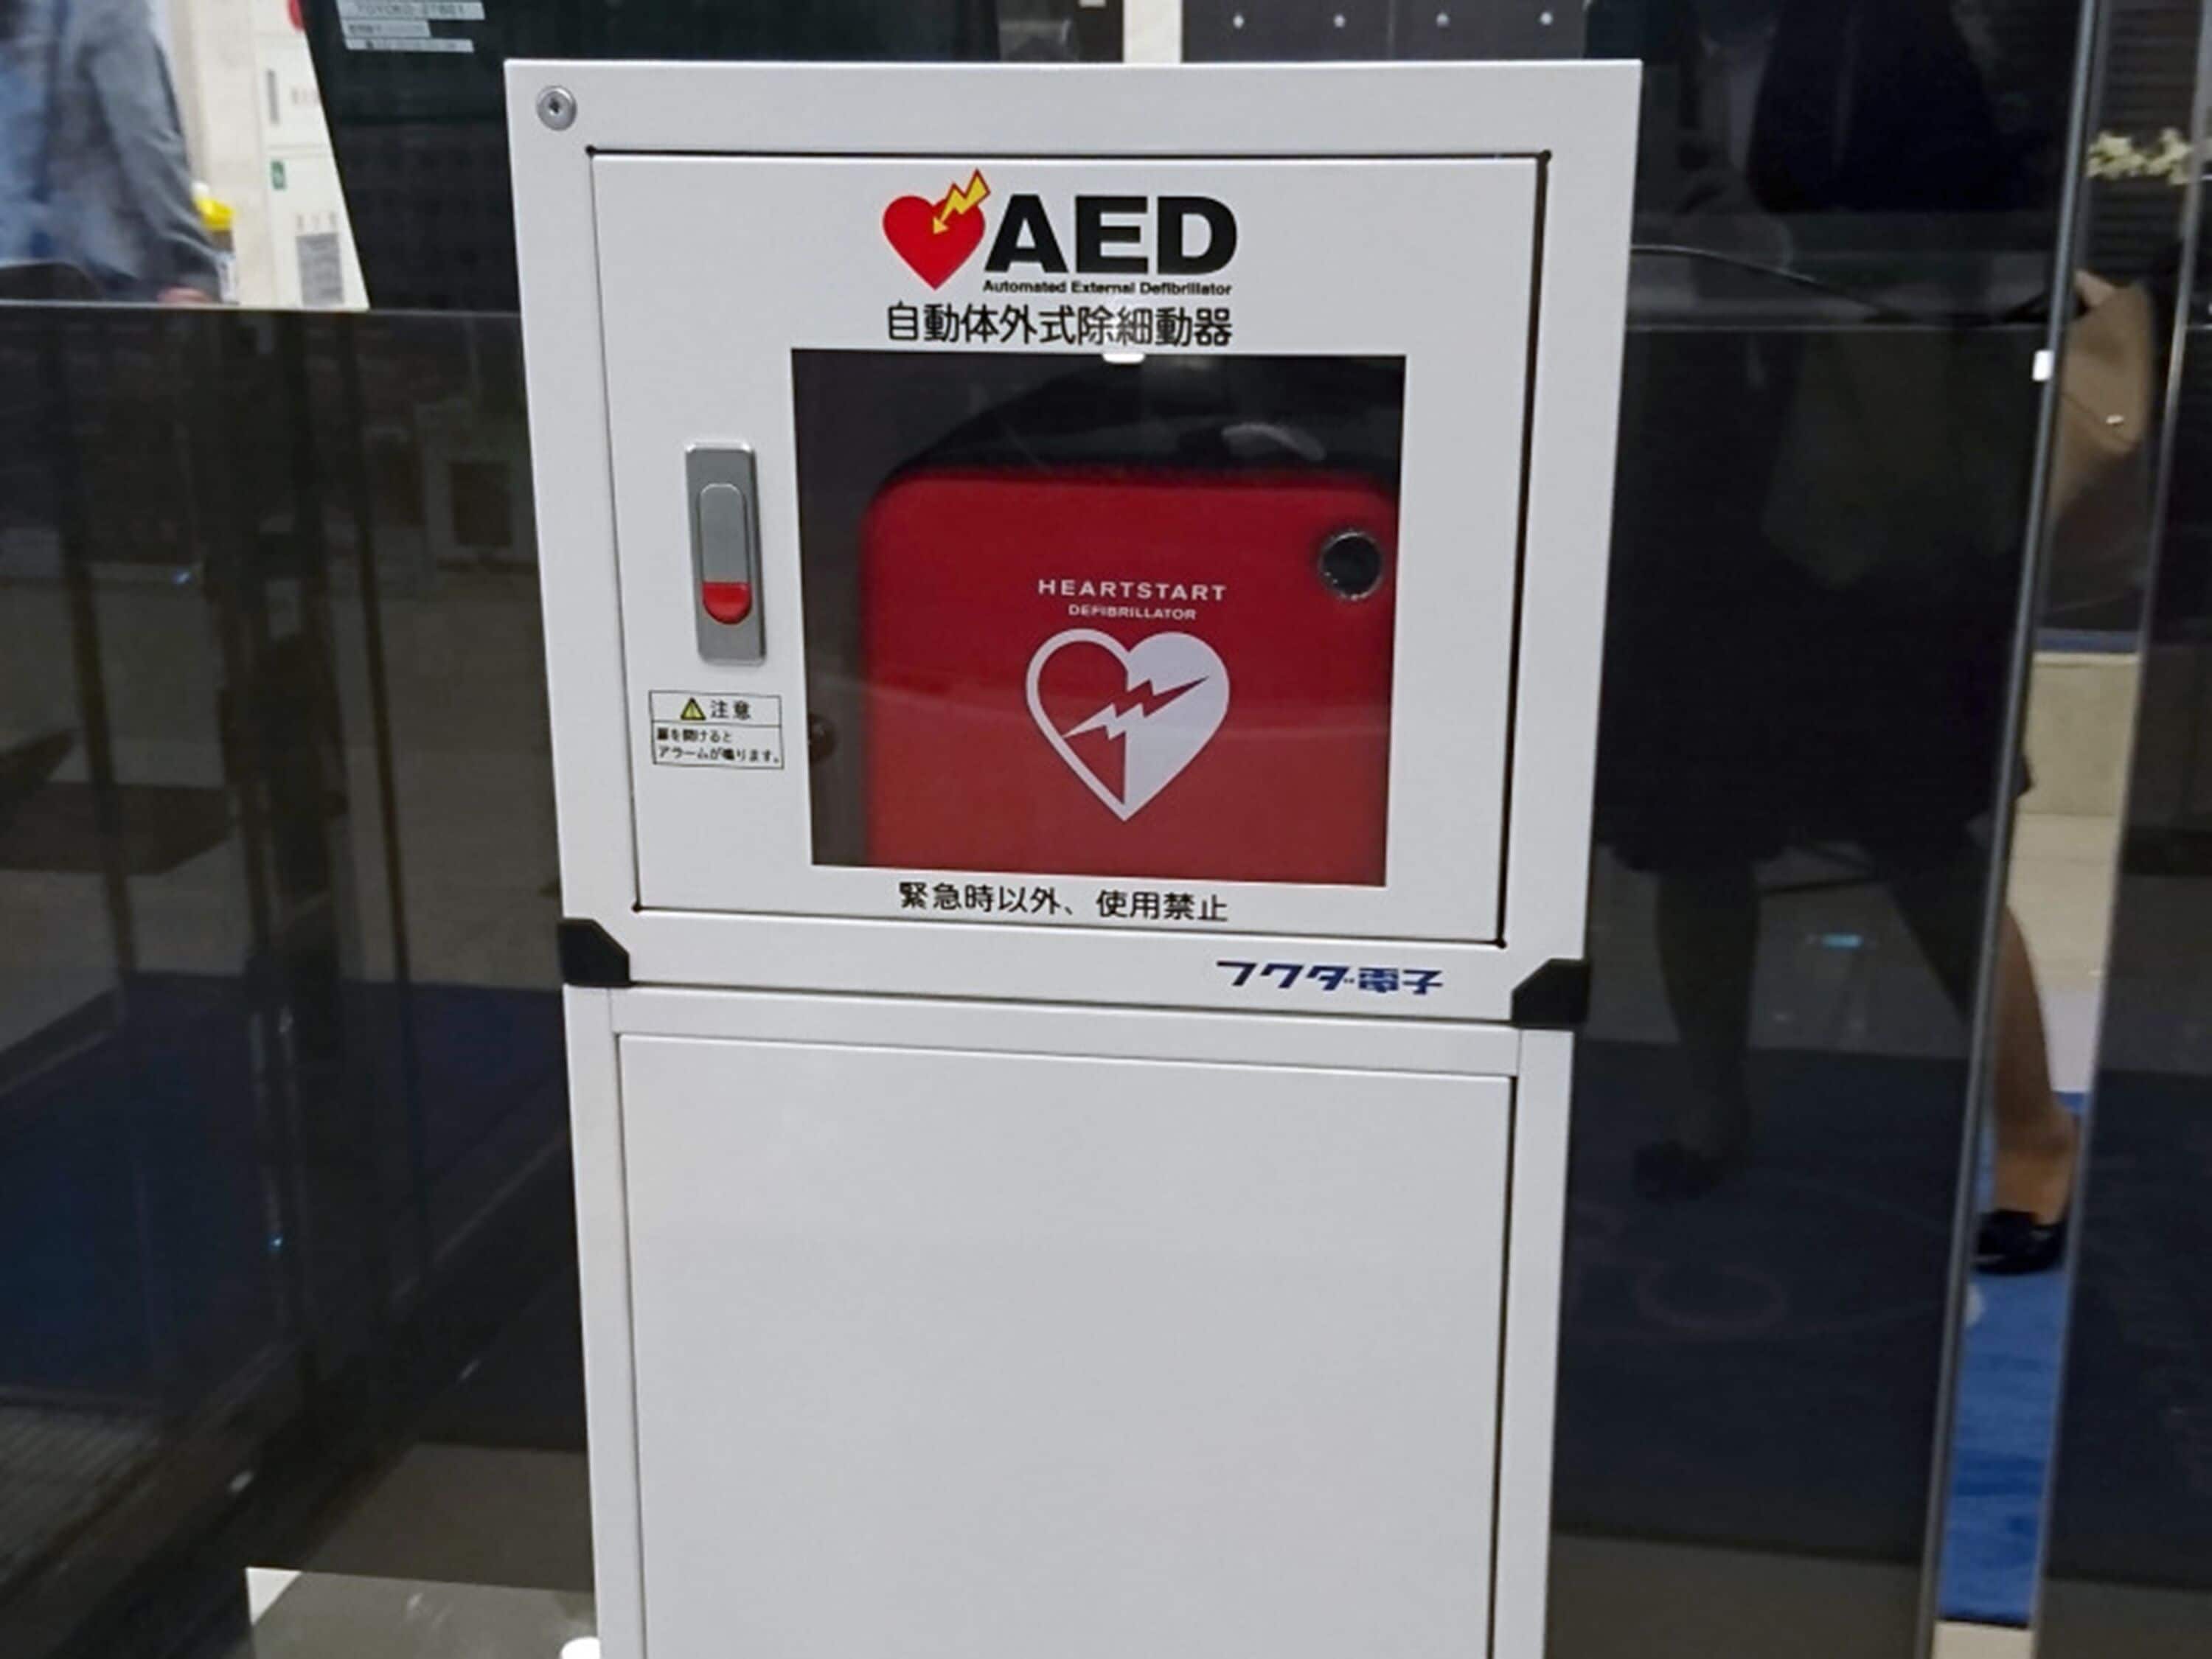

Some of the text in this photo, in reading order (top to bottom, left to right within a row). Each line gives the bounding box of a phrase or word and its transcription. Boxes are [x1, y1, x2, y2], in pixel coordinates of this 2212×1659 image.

[984, 195, 1237, 275] AED
[983, 279, 1232, 296] Automated External Defibrillator
[887, 301, 1233, 347] 自動体外式除細動器
[1037, 579, 1227, 601] HEARTSTART
[1068, 604, 1197, 620] DEFIBRILLATOR
[711, 700, 751, 720] 注意
[898, 882, 1229, 922] 緊急時以外、使用禁止
[1217, 960, 1443, 995] フクダ電子
